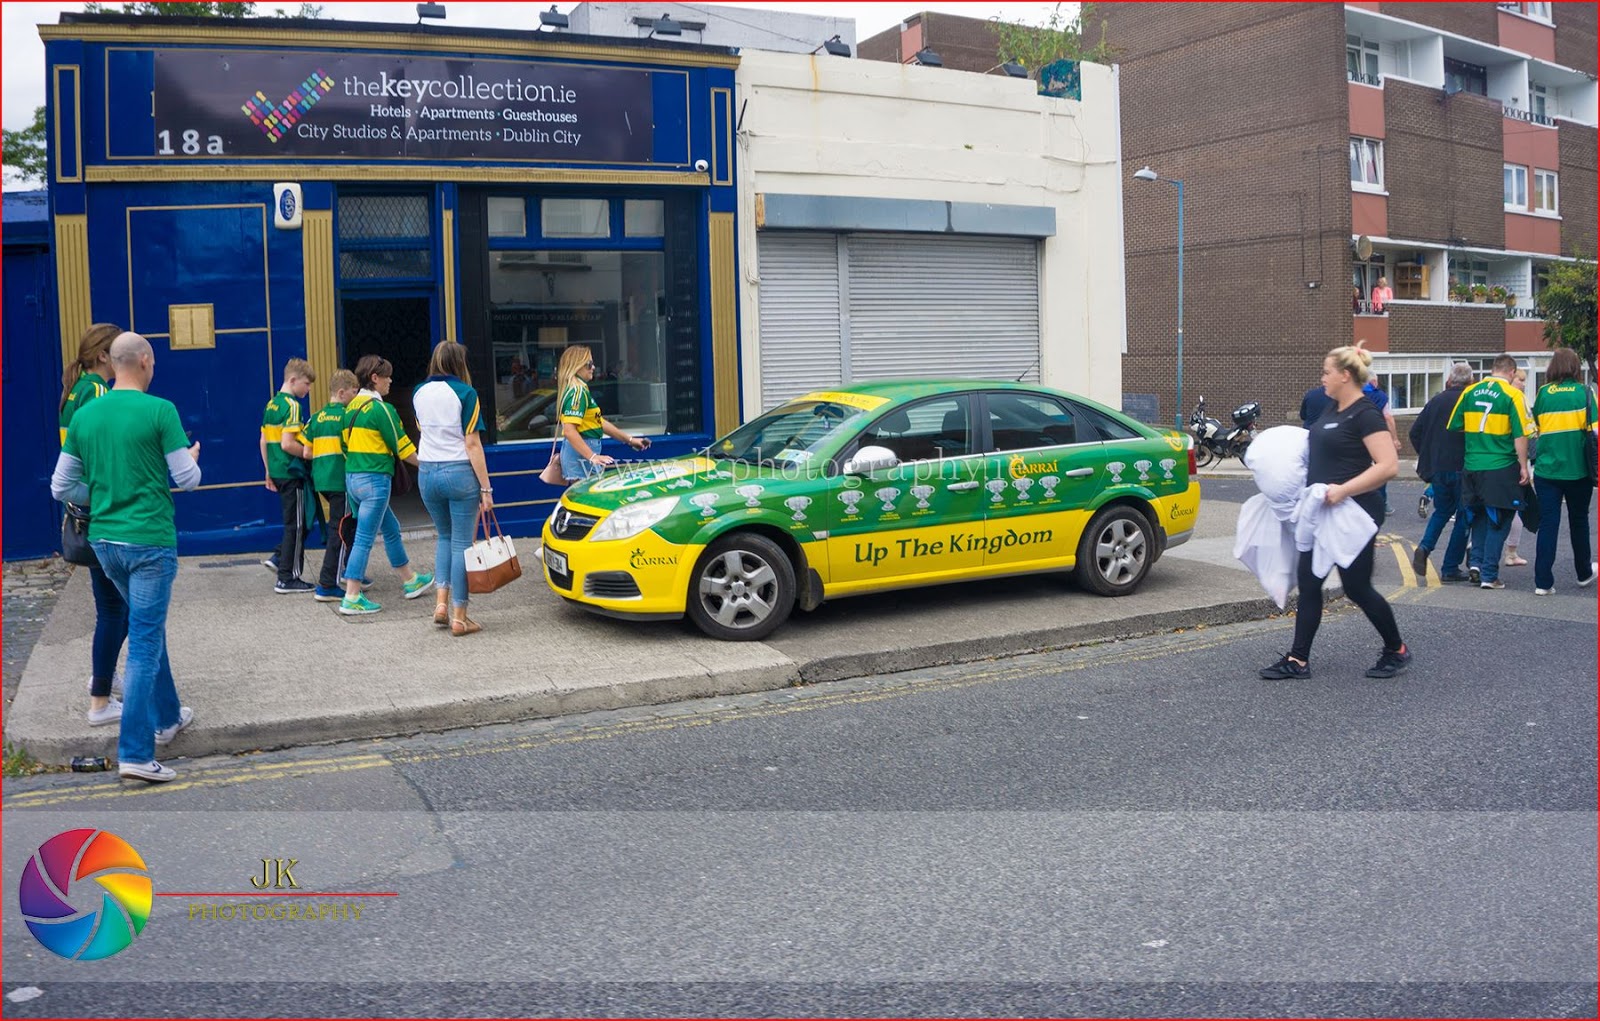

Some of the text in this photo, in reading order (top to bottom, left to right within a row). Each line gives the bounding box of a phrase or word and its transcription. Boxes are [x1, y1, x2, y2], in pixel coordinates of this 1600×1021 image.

[343, 71, 576, 104] thekeycollection.ie
[370, 104, 577, 123] Hotels Apartments Guesthouses
[297, 123, 581, 145] City Studios & Apartments Dublin City
[1475, 401, 1493, 433] 7
[855, 529, 1053, 566] Up The Kingdom
